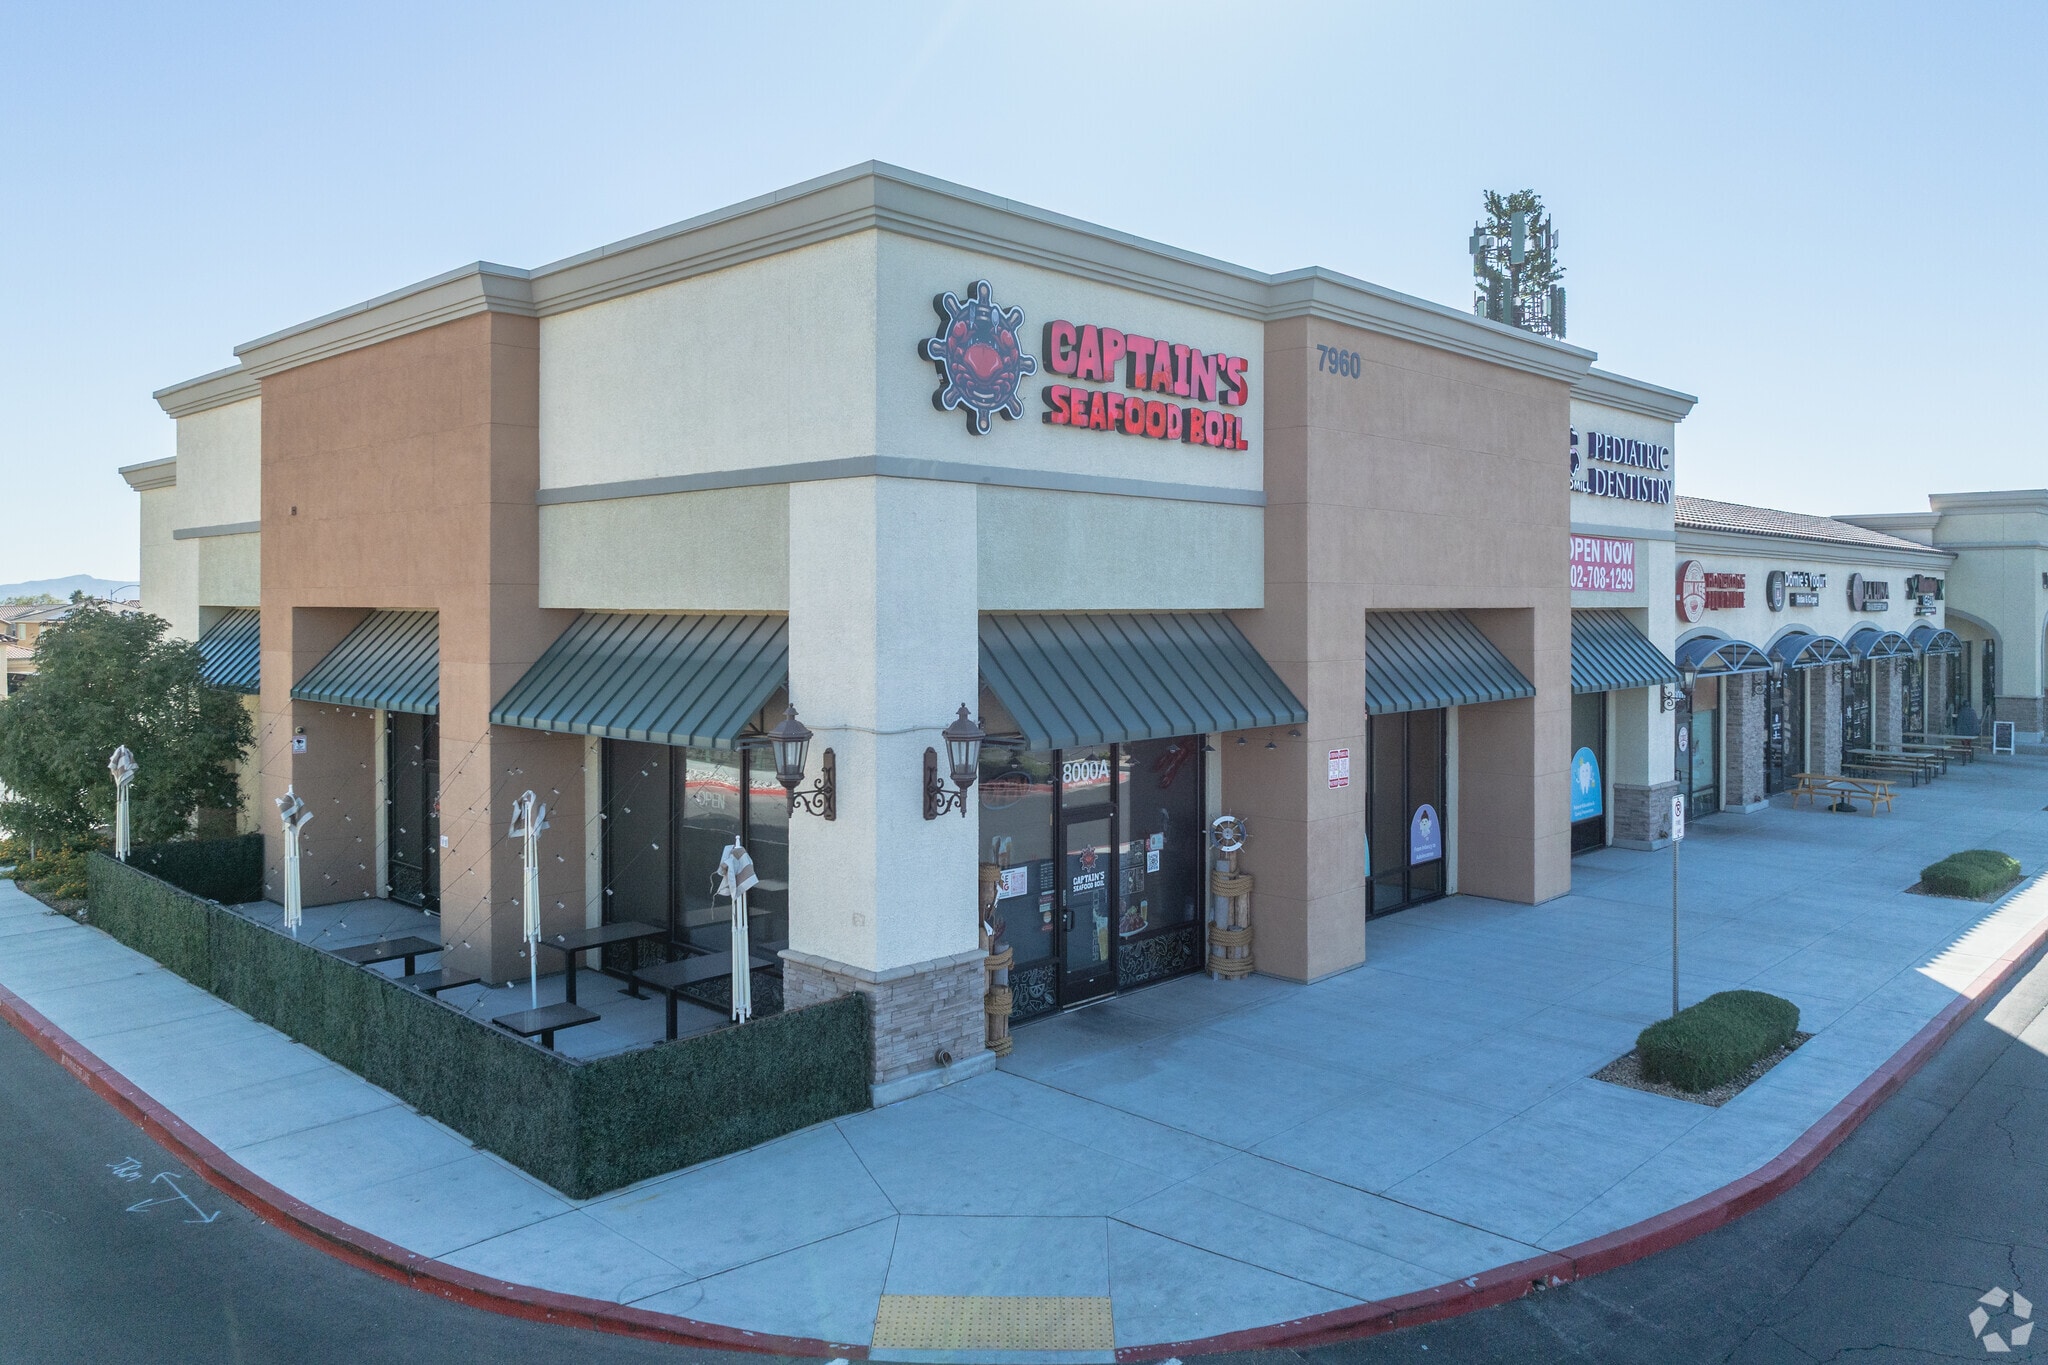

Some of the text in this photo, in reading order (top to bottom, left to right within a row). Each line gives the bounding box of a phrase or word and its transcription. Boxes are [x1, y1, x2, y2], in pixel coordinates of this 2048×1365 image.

[1043, 319, 1248, 406] CAPTAIN'S
[1316, 344, 1361, 379] 7960
[1043, 385, 1248, 450] SEAFOOD BOIL
[1594, 432, 1669, 471] PEDIATRIC
[1594, 468, 1674, 505] DENTISTRY
[1604, 540, 1634, 565] NOW
[1063, 759, 1110, 784] 8000A
[1073, 871, 1105, 885] CAPTAIN'S
[1073, 882, 1093, 892] SEAFOOD
